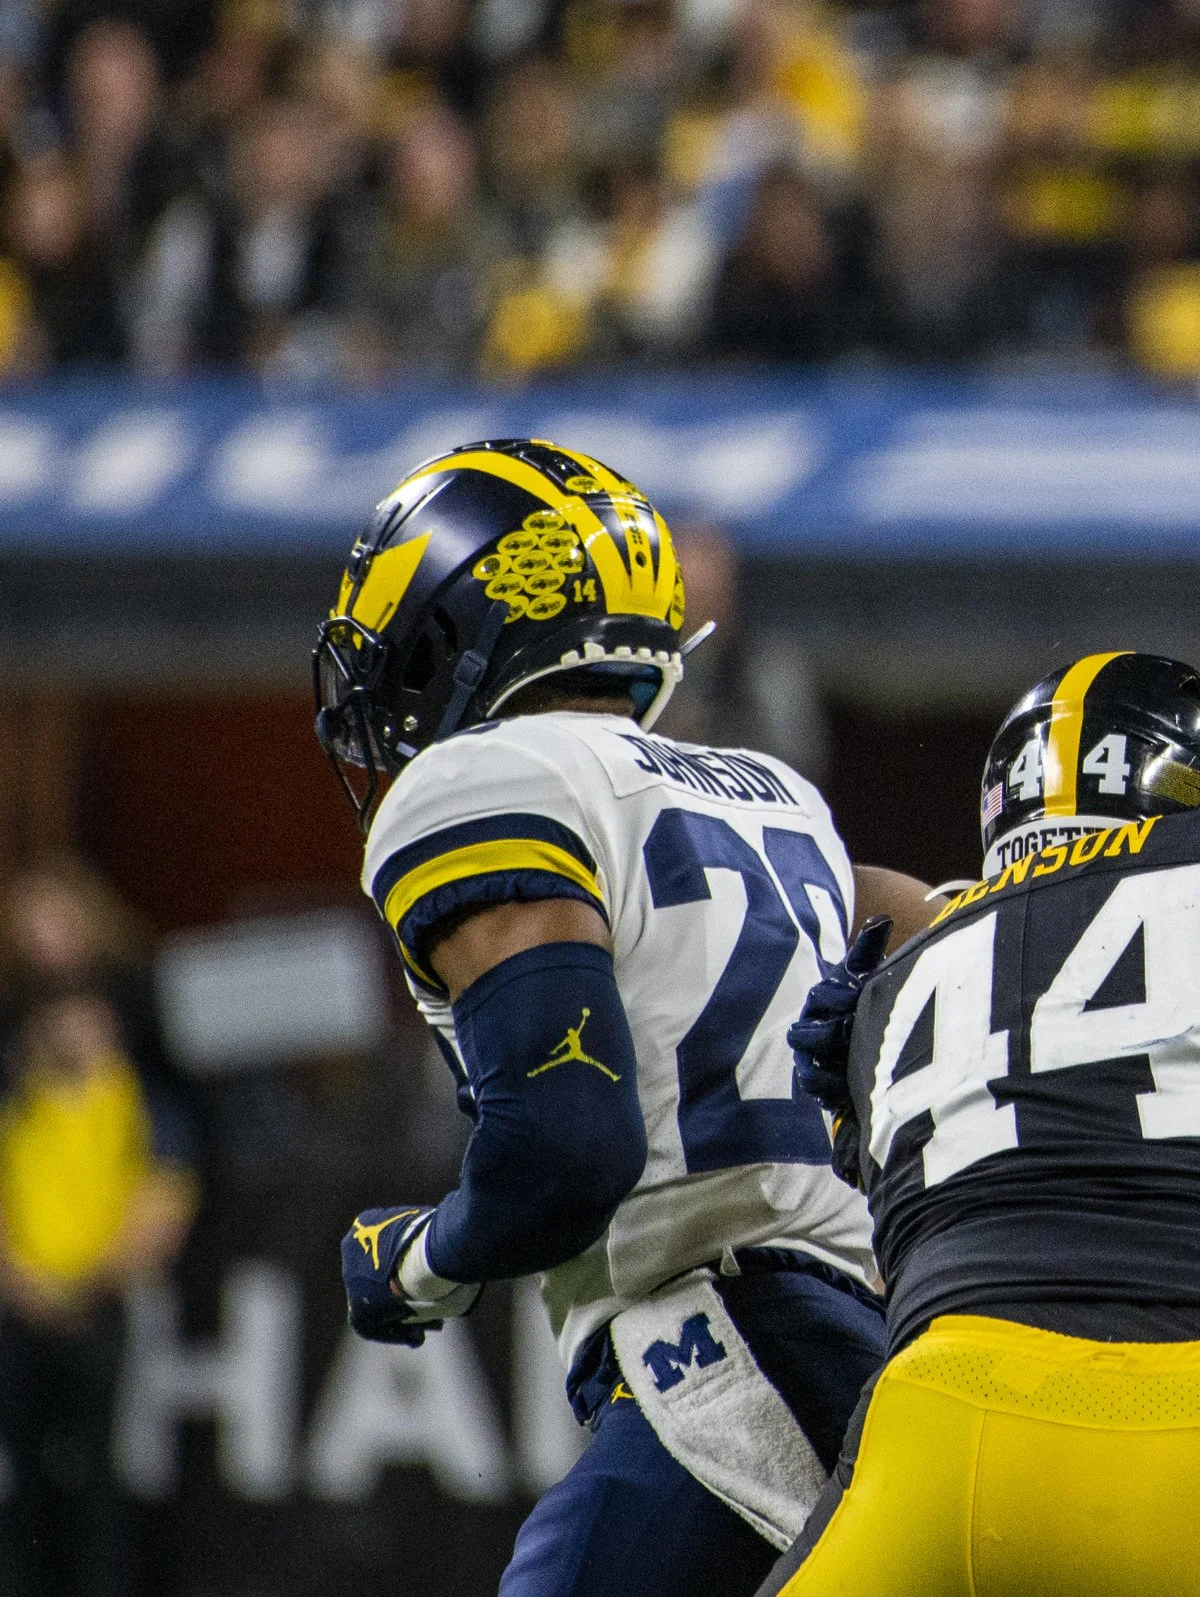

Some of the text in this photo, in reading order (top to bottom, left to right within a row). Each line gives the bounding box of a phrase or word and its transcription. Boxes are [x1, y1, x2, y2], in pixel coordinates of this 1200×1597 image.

[574, 579, 597, 602] 14
[616, 734, 800, 806] JOHNSON
[996, 826, 1108, 871] TOGET
[642, 1312, 728, 1394] M
